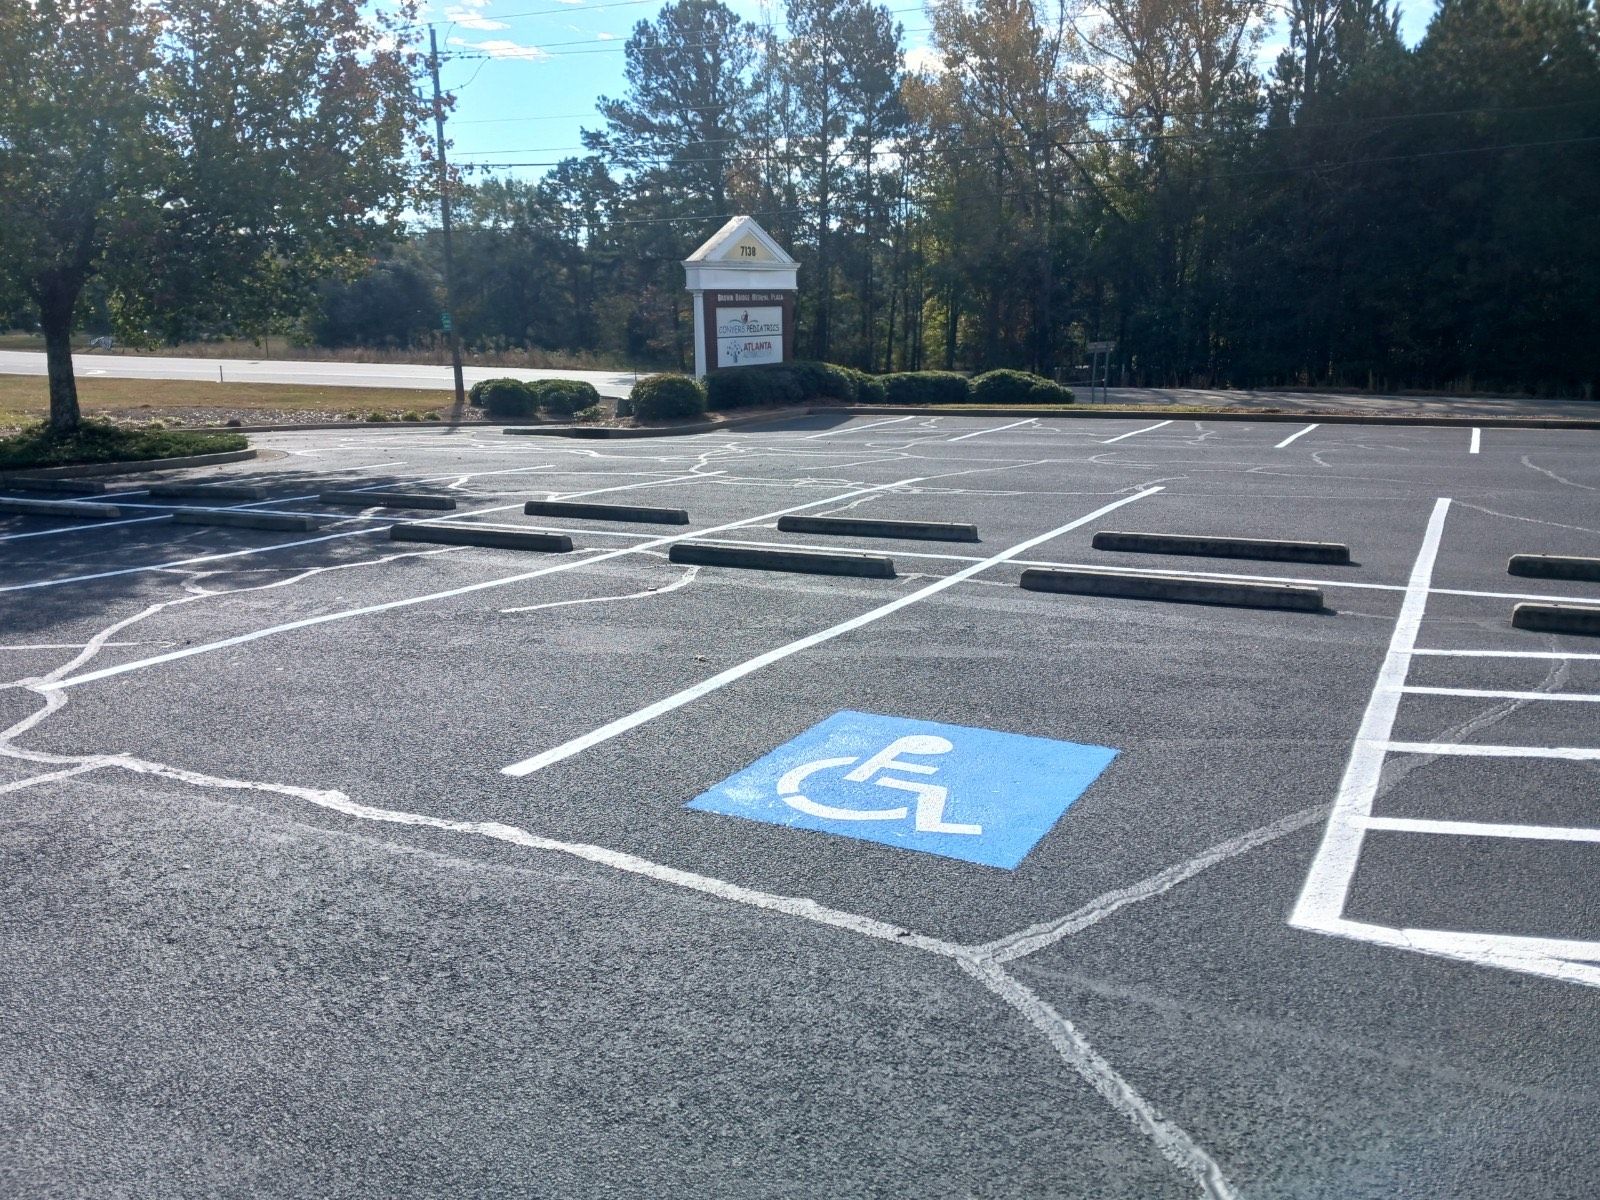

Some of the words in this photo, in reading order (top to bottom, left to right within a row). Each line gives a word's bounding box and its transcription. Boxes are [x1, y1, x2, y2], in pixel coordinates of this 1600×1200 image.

[740, 246, 756, 257] 7138
[718, 325, 745, 334] CONYERS
[746, 323, 780, 333] PEDIATRICS
[743, 341, 772, 352] ATLANTA
